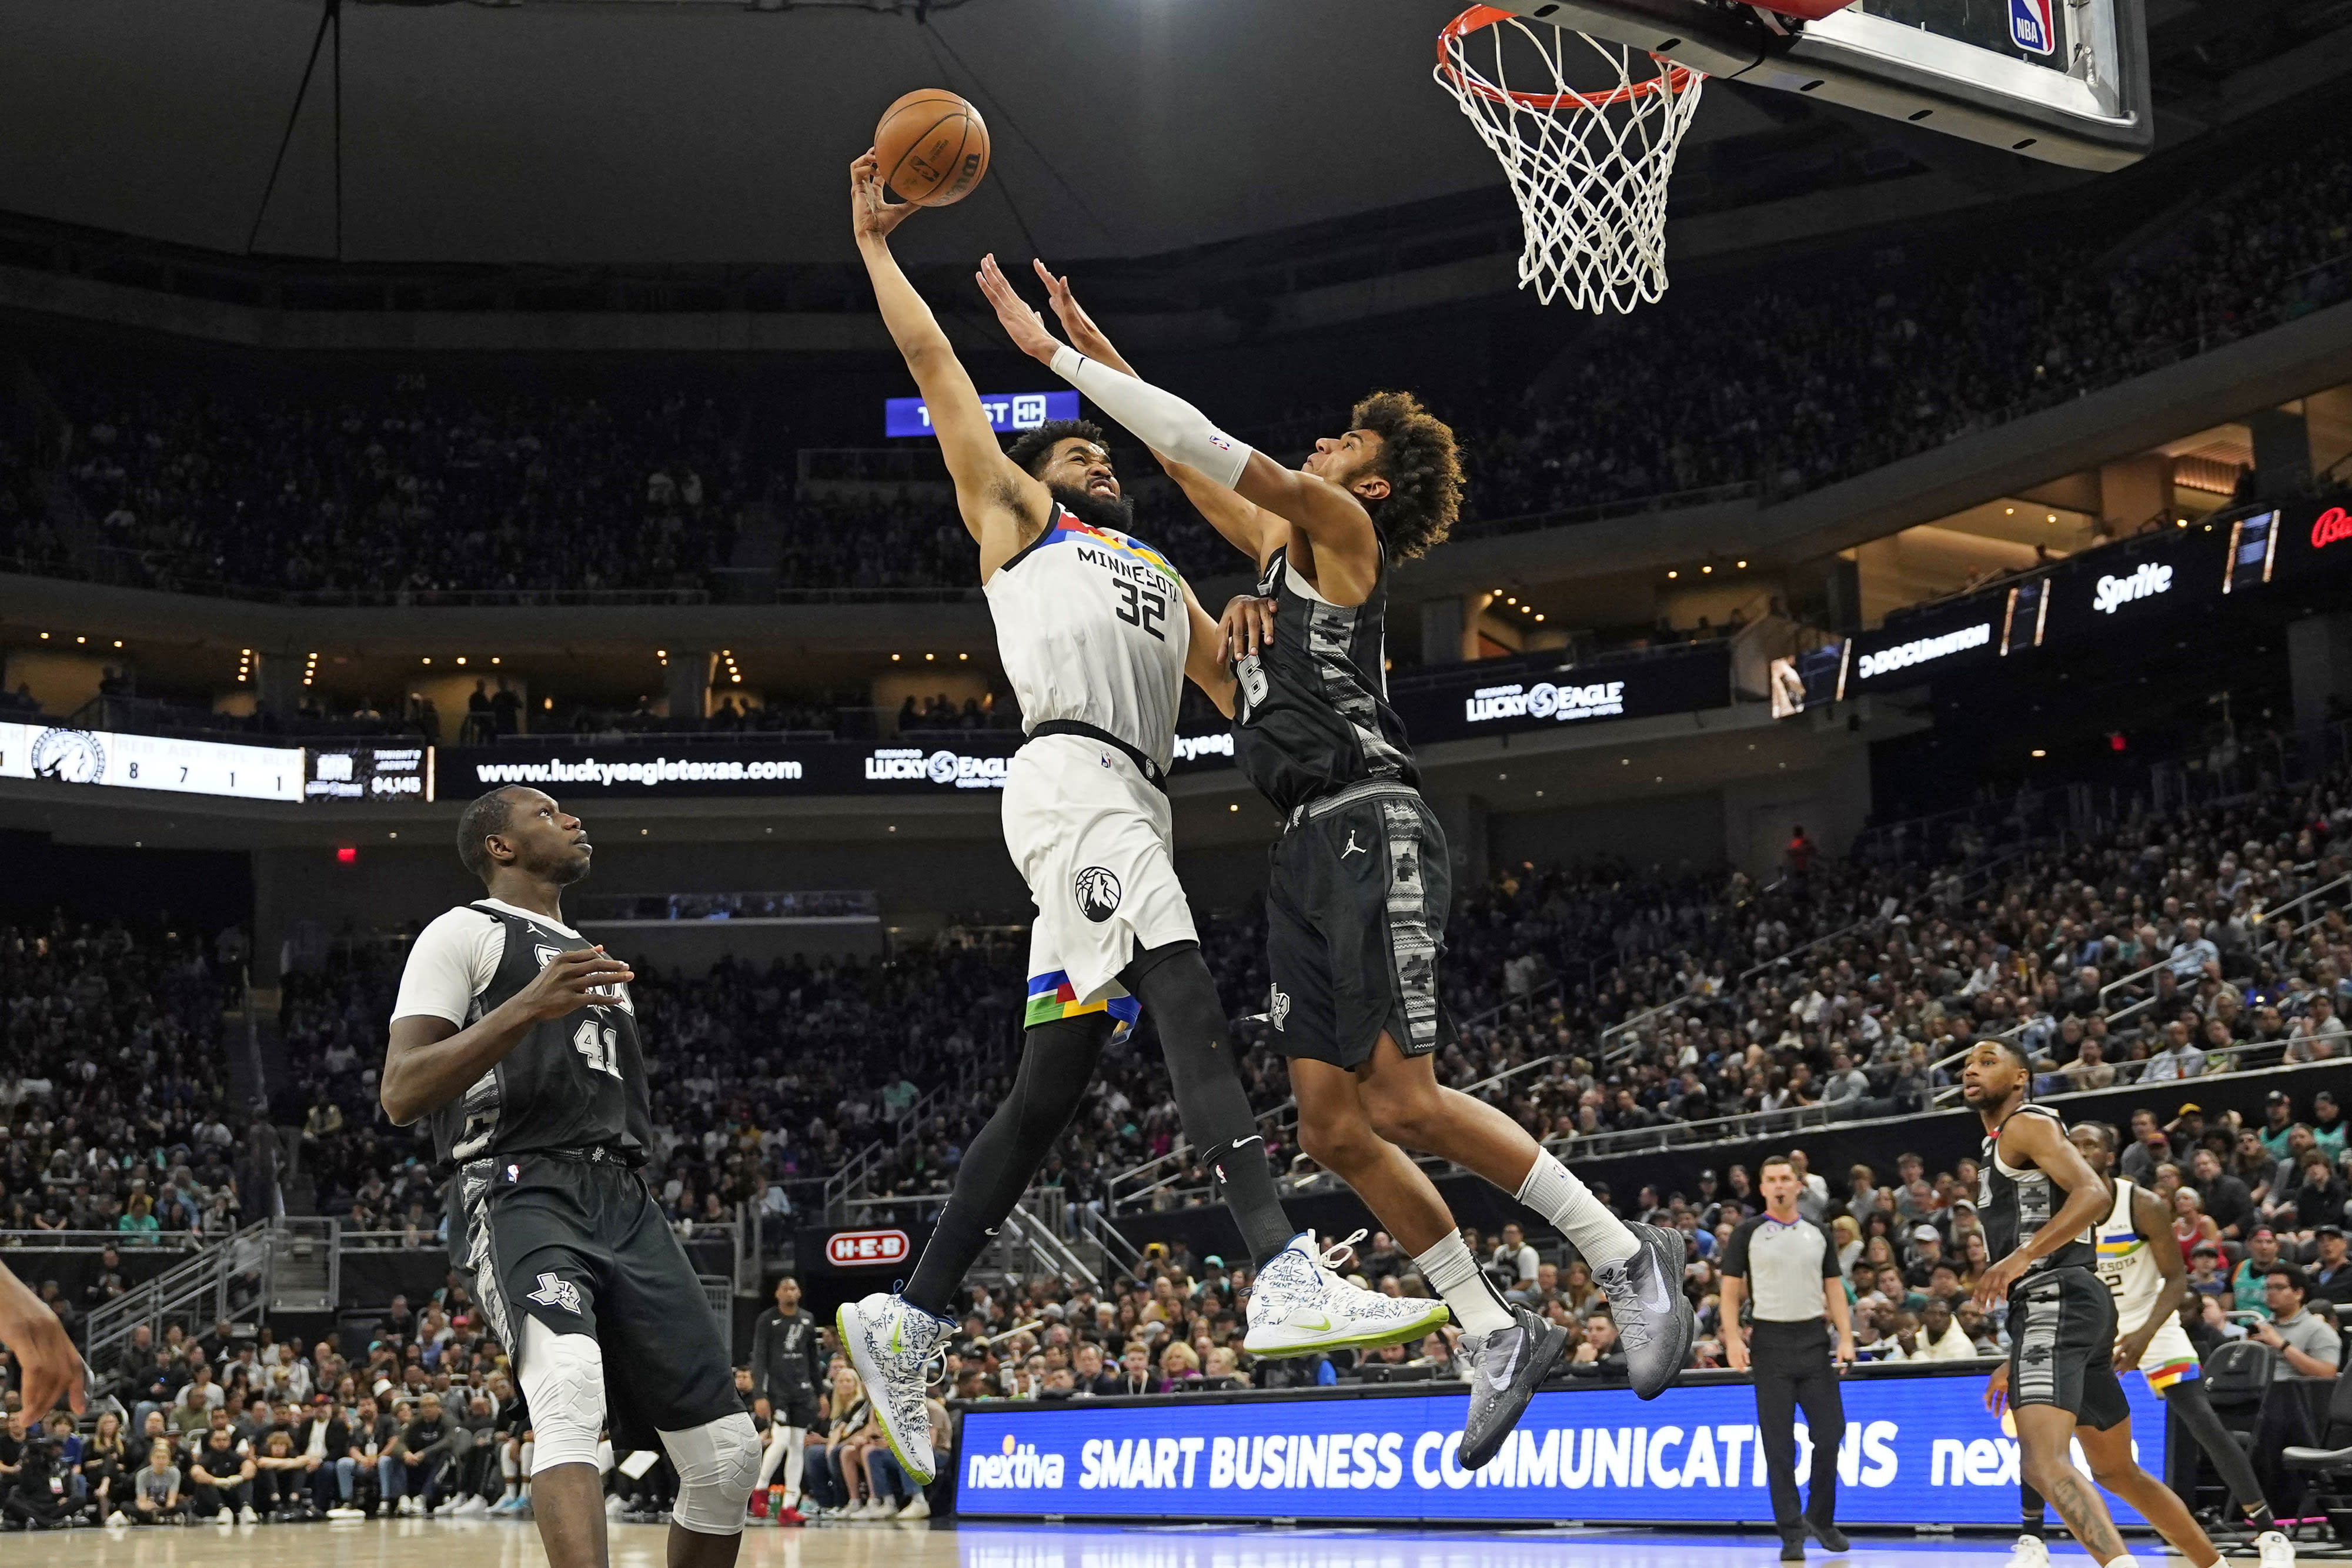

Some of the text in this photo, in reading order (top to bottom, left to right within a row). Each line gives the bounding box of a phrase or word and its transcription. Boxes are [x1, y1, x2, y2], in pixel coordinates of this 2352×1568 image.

[2016, 17, 2039, 43] NBA
[2093, 563, 2173, 614] Sprite
[1112, 577, 1165, 642] 32
[1466, 681, 1625, 721] LUCKY EAGLE
[129, 762, 138, 779] 8
[180, 767, 188, 783] 7
[230, 772, 235, 787] 1
[277, 776, 282, 791] 1
[476, 758, 803, 786] www.luckyeagletexas.com
[865, 757, 929, 779] LUCKY
[573, 1020, 623, 1080] 41
[968, 1443, 1064, 1489] nextiva
[1078, 1437, 1204, 1490] SMART
[1209, 1432, 1404, 1490] BUSINESS
